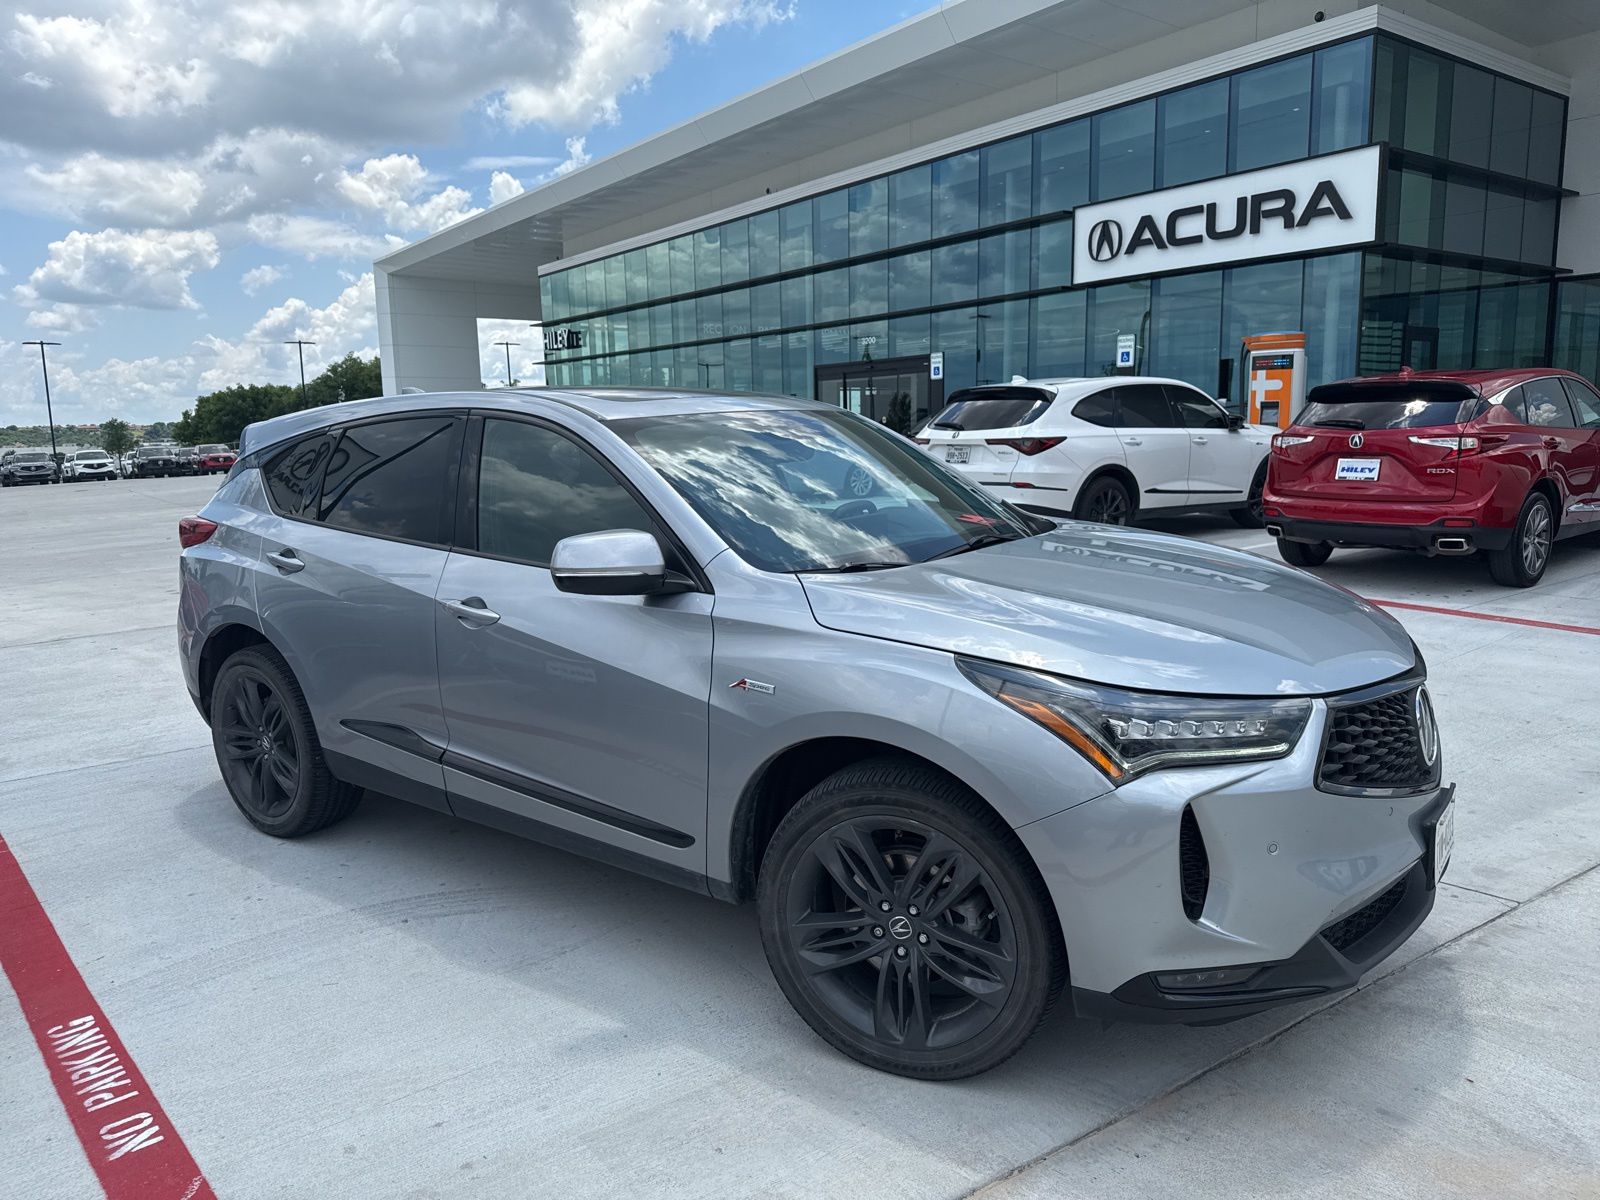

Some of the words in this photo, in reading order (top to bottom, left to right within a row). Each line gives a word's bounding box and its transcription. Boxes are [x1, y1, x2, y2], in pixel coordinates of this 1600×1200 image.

[1124, 179, 1354, 255] ACURA
[861, 336, 877, 346] 3200
[1340, 466, 1376, 474] HILEY
[46, 1014, 140, 1113] PARKING
[99, 1111, 165, 1162] NO
